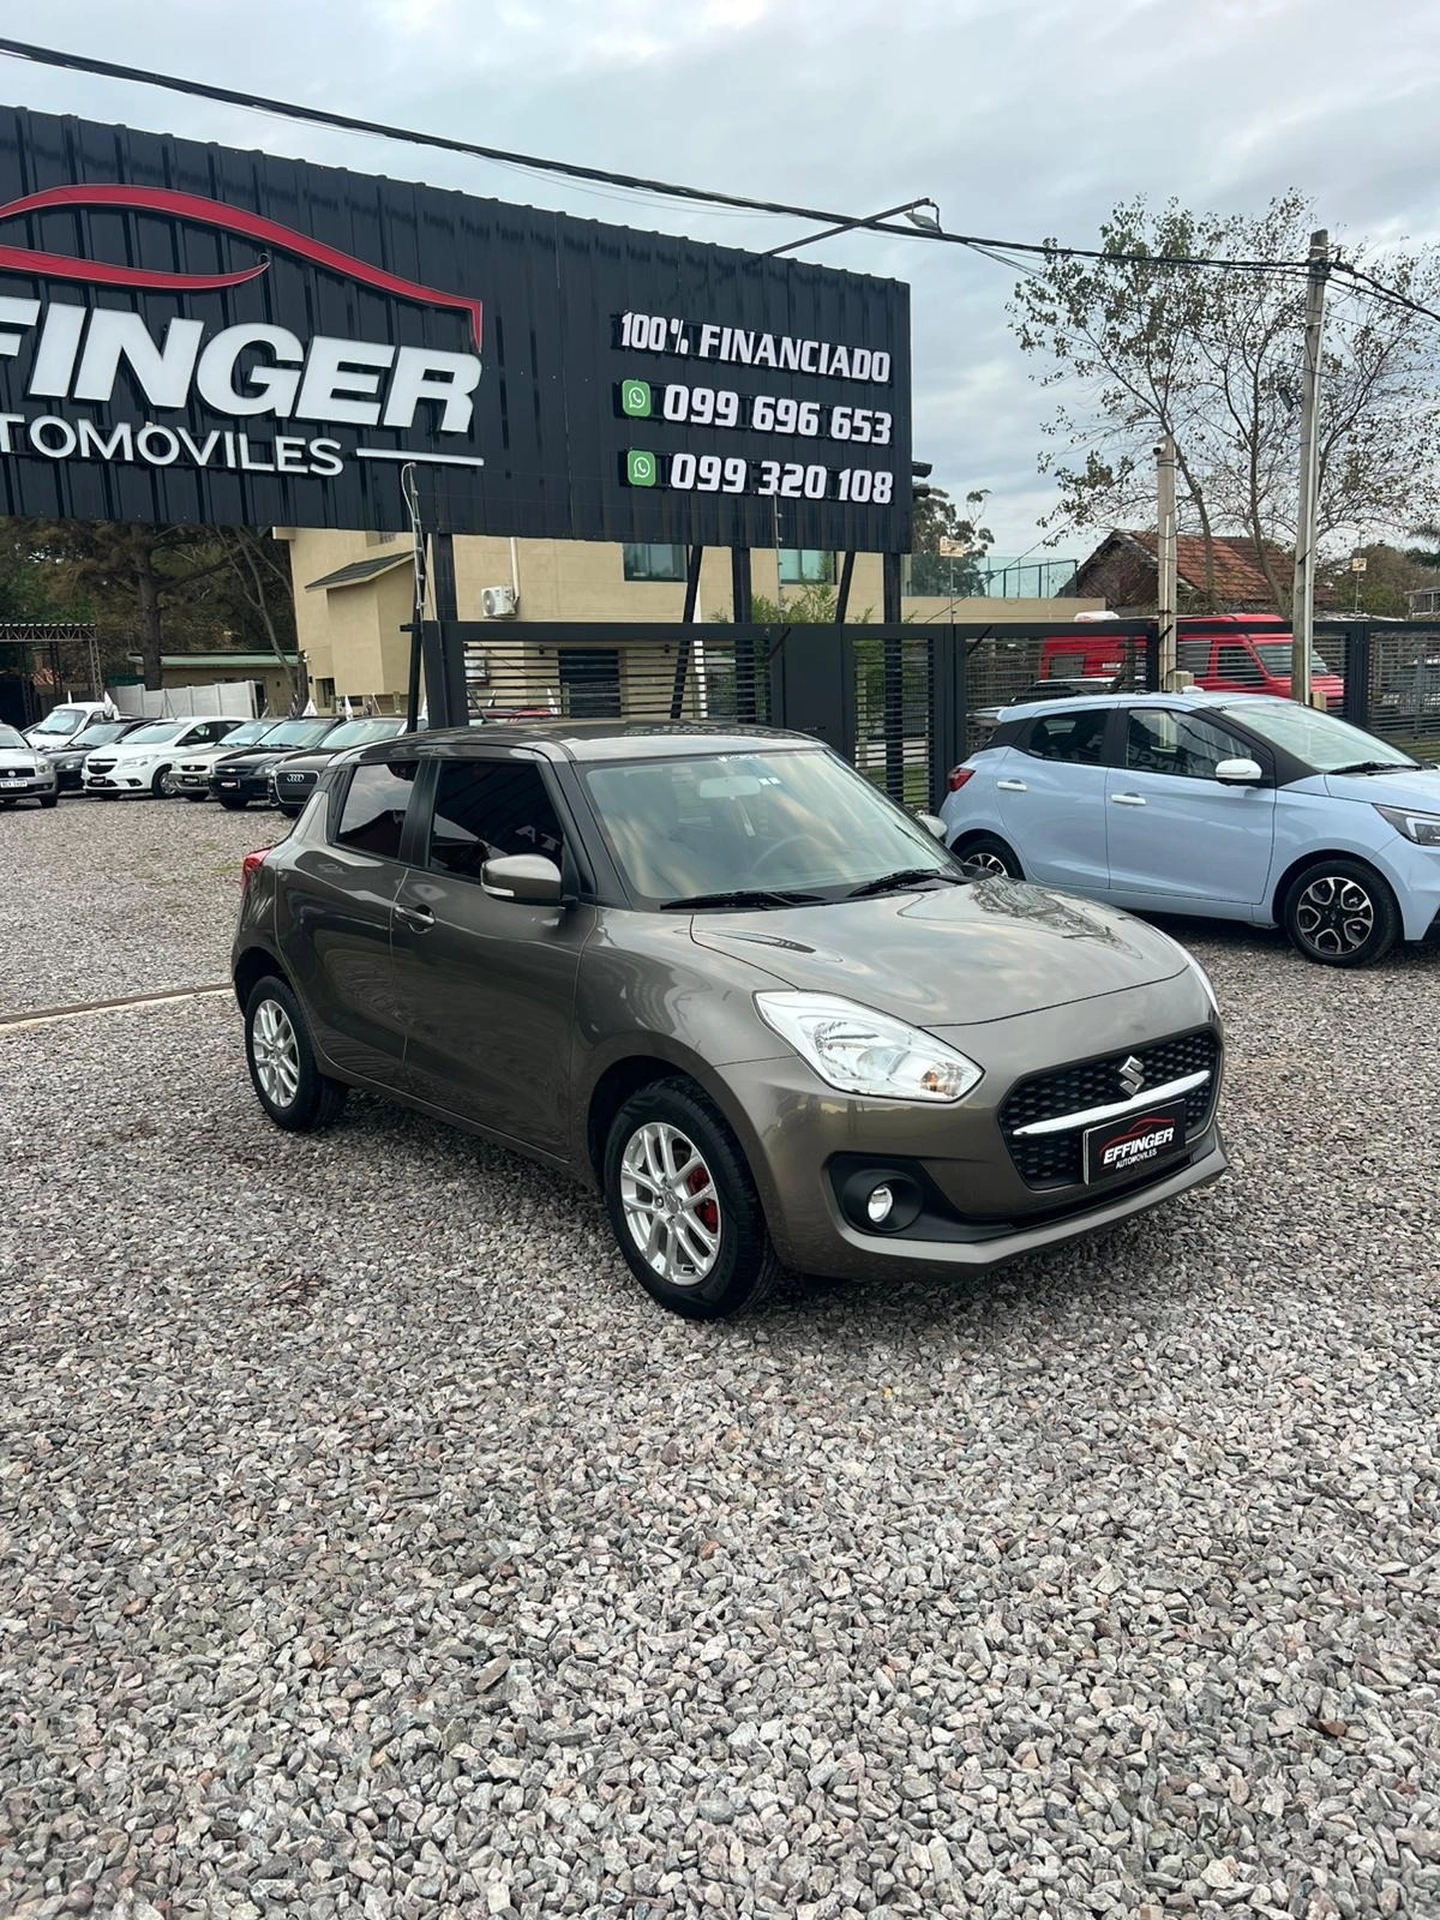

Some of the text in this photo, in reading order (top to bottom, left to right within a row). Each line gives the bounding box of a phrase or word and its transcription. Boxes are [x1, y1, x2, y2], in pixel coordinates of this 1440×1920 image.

[621, 311, 891, 383] 100% FINANCIADO
[663, 384, 892, 445] 099 696 653
[670, 453, 893, 504] 099 320 108
[1103, 1127, 1174, 1164] EFFINGER
